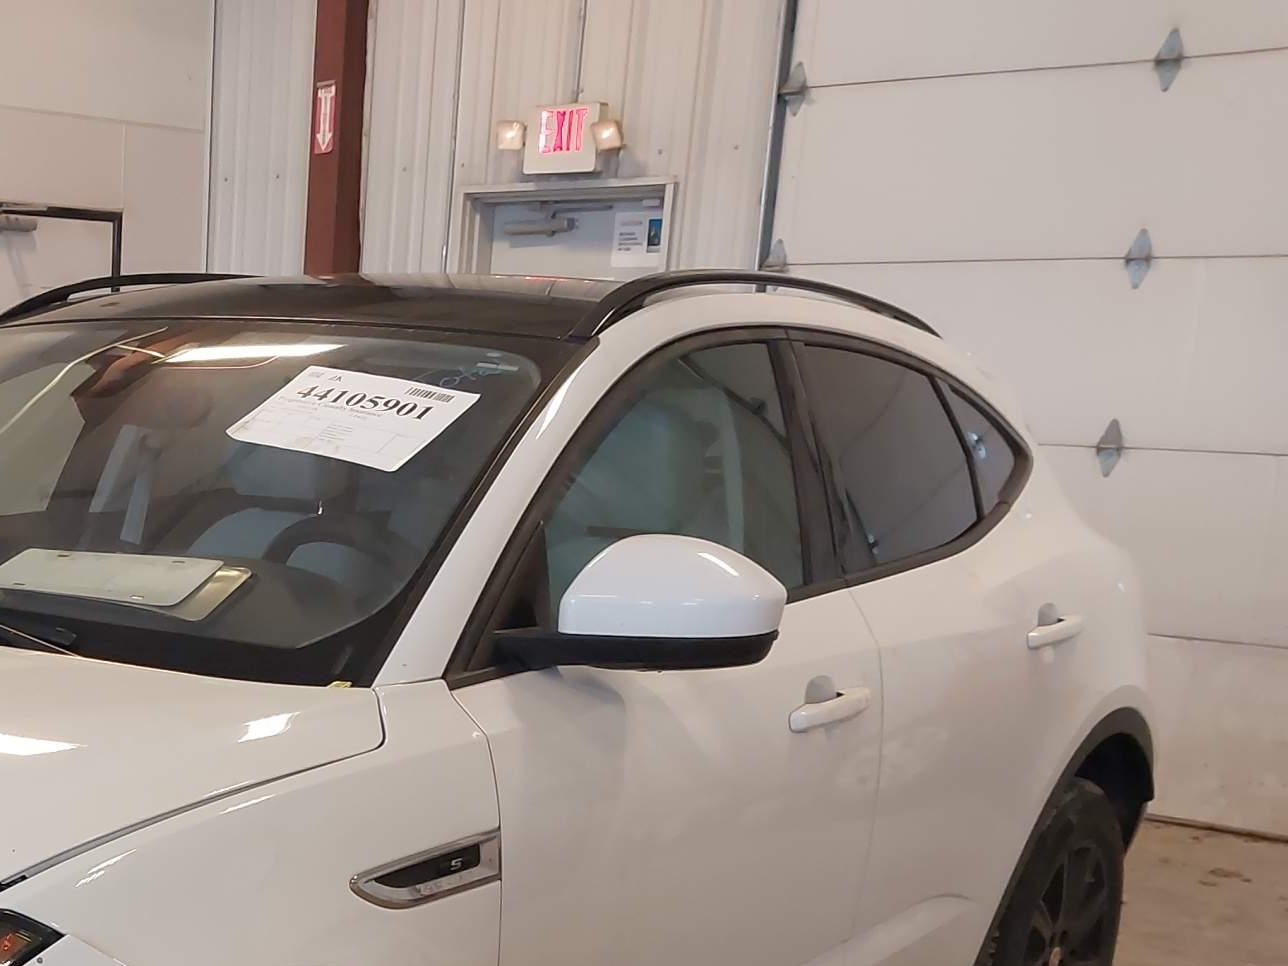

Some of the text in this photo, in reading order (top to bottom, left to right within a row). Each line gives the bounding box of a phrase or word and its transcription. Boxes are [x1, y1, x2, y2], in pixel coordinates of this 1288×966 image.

[539, 108, 588, 153] EXIT
[296, 385, 434, 421] 44105901
[450, 858, 463, 870] S
